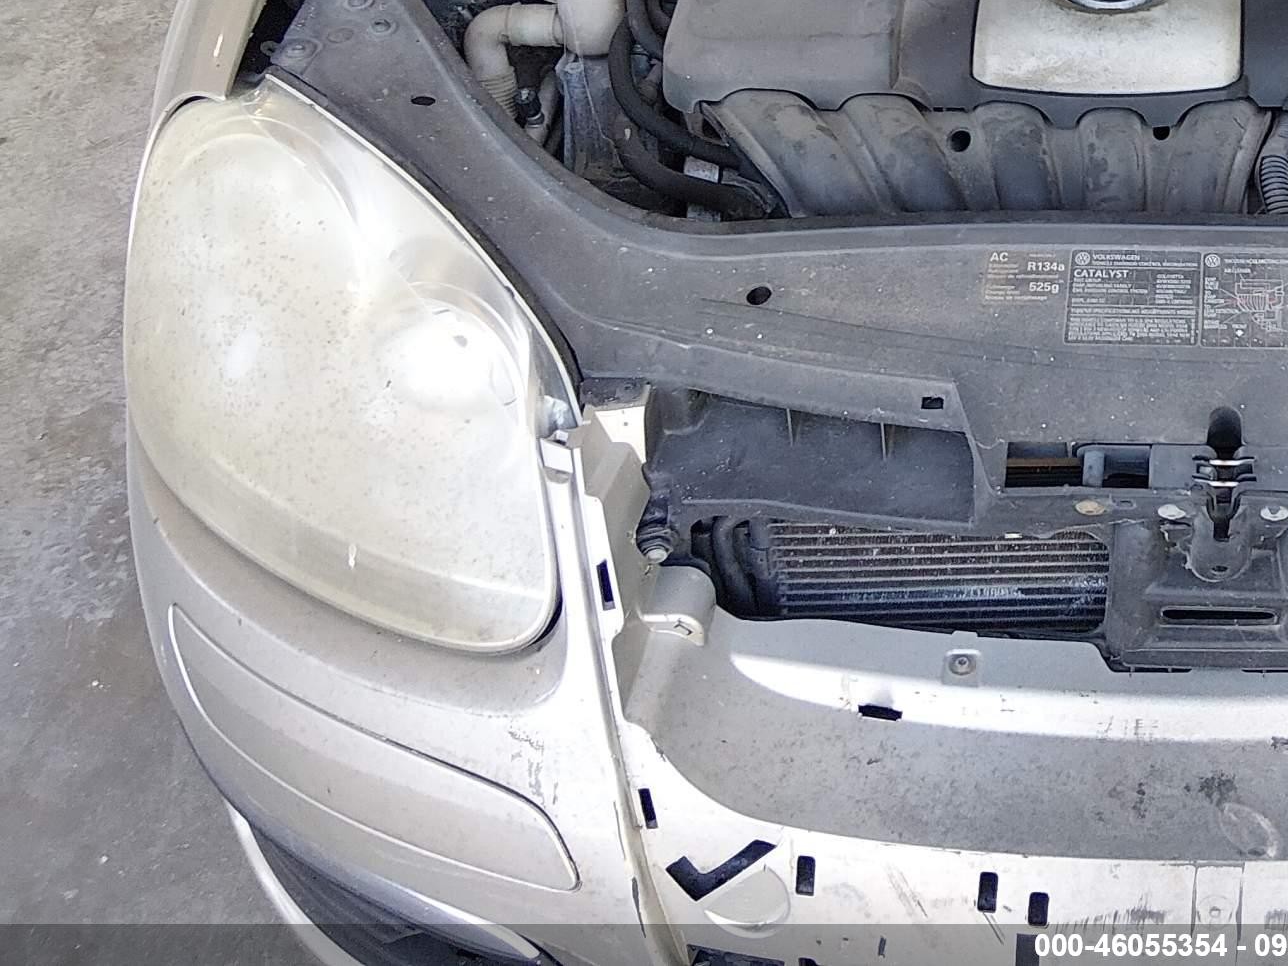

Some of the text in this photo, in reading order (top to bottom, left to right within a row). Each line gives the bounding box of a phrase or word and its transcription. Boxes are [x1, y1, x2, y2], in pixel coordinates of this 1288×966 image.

[990, 252, 1009, 262] AC
[1092, 254, 1142, 262] VOLKSWAGEN
[1027, 261, 1065, 272] R134a
[1073, 269, 1130, 279] CATALYST
[1029, 281, 1060, 294] 525g
